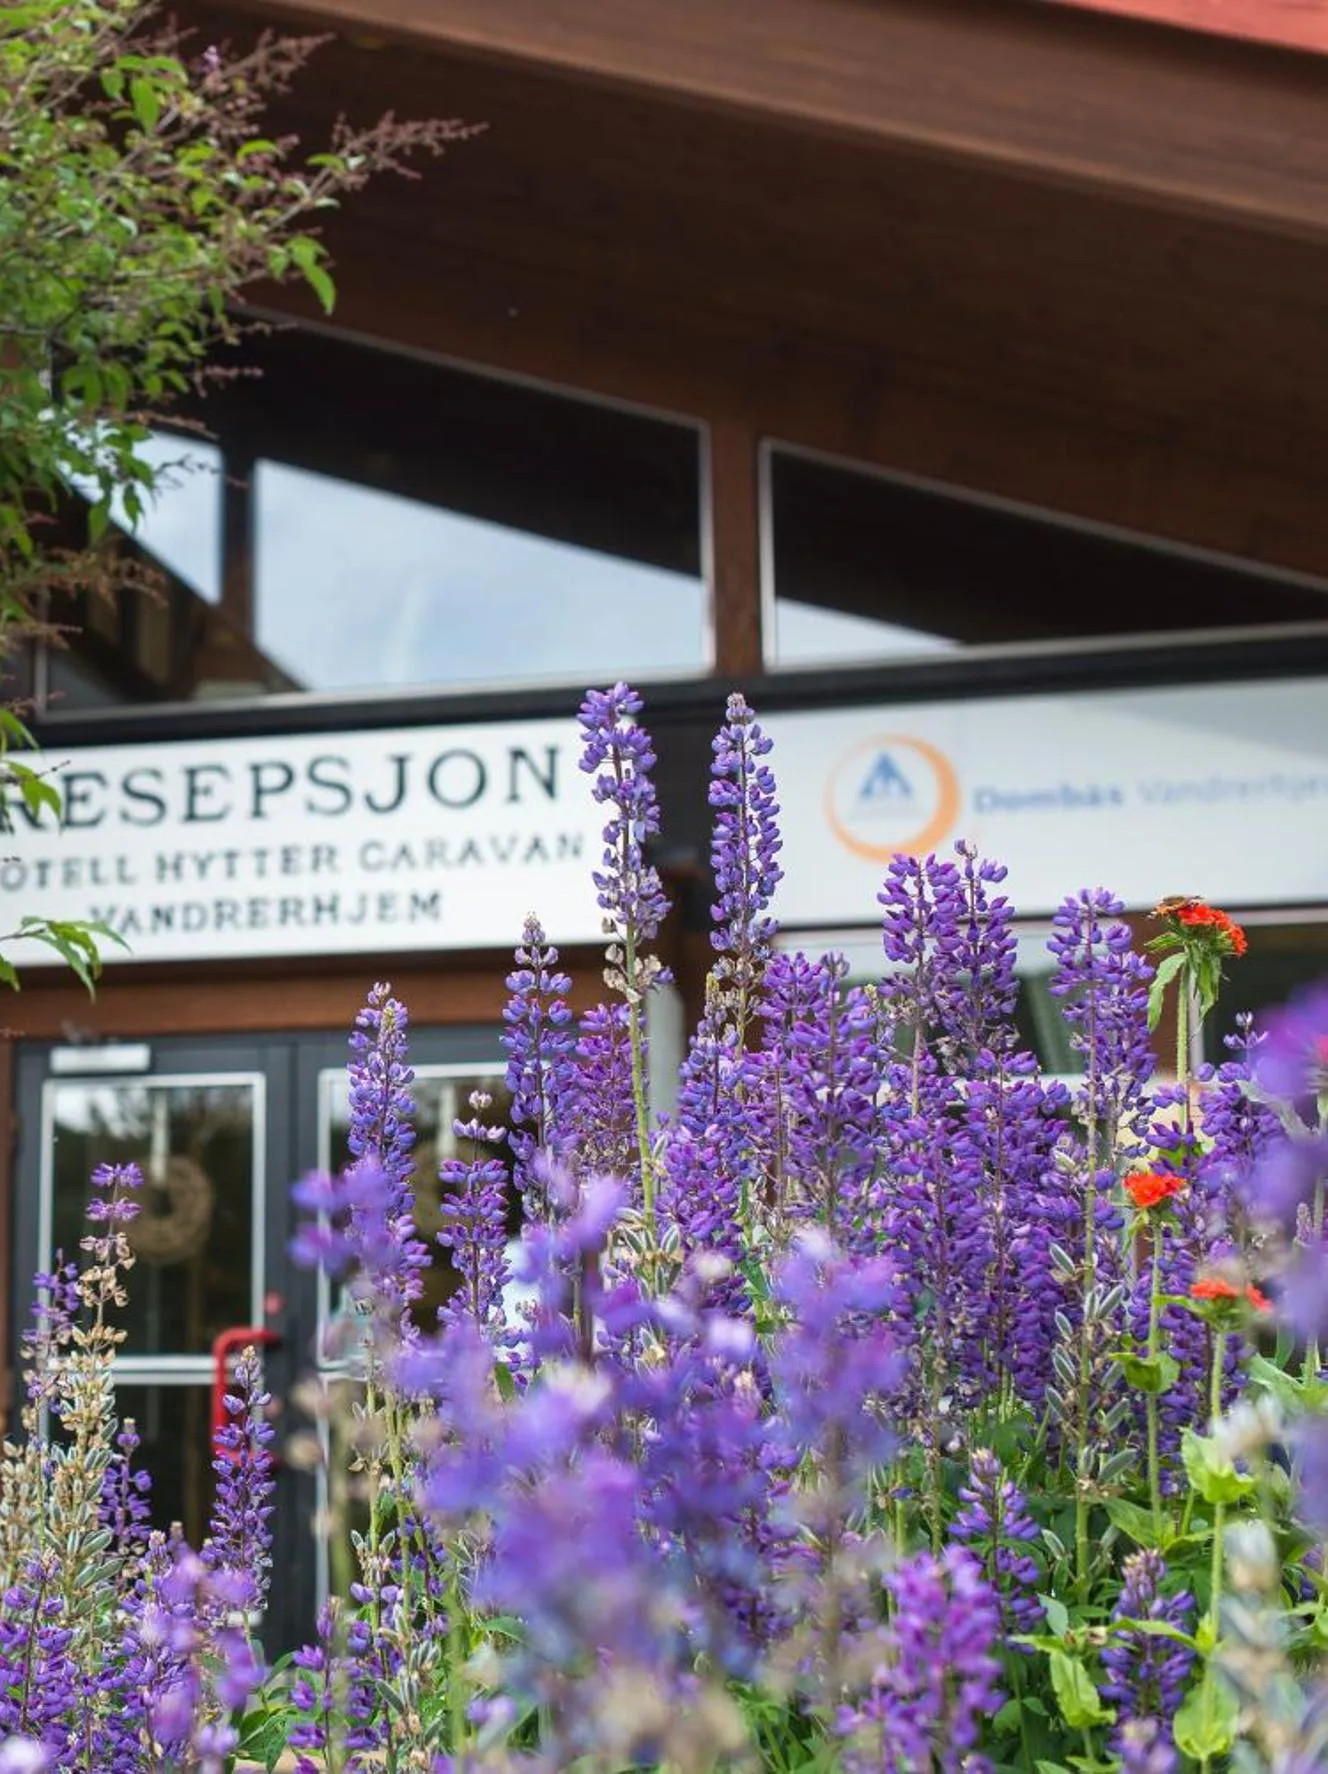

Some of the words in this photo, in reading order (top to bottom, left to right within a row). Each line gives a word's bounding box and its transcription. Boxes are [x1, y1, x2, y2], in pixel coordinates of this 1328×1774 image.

[153, 844, 339, 881] HYTTER
[356, 833, 585, 872] CARAVAN
[88, 890, 443, 936] VANDRERHJEM
